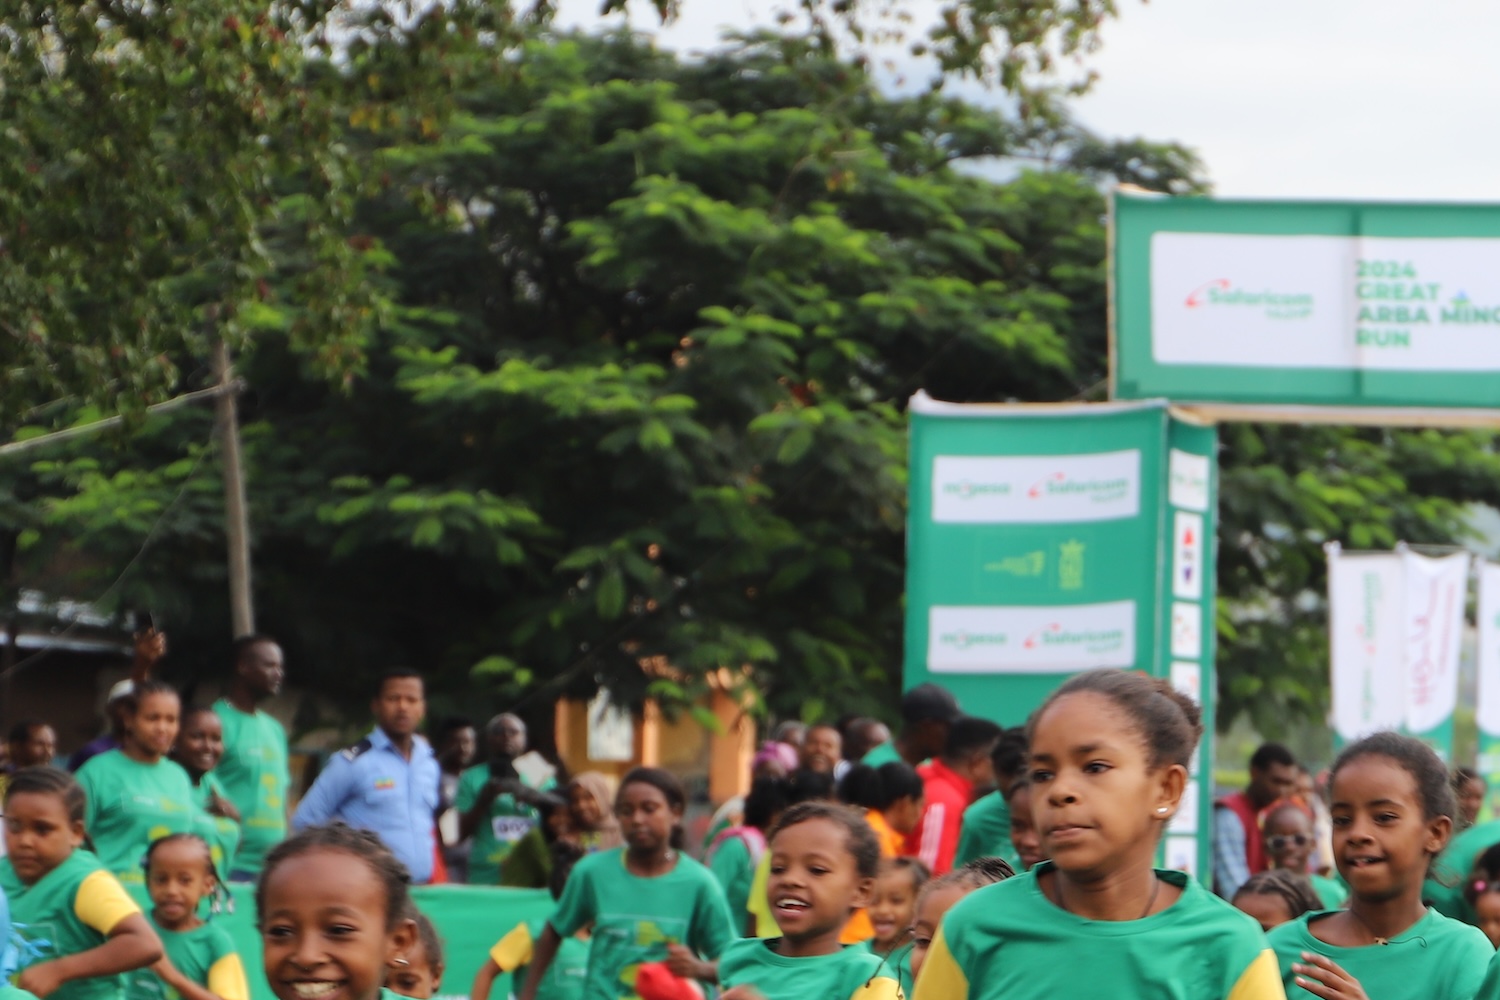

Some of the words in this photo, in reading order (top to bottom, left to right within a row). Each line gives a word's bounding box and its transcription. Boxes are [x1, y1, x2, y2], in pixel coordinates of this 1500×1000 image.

[1355, 260, 1417, 278] 2024
[1355, 282, 1442, 301] GREAT
[1356, 306, 1430, 325] ARBA
[1355, 329, 1411, 348] RUN
